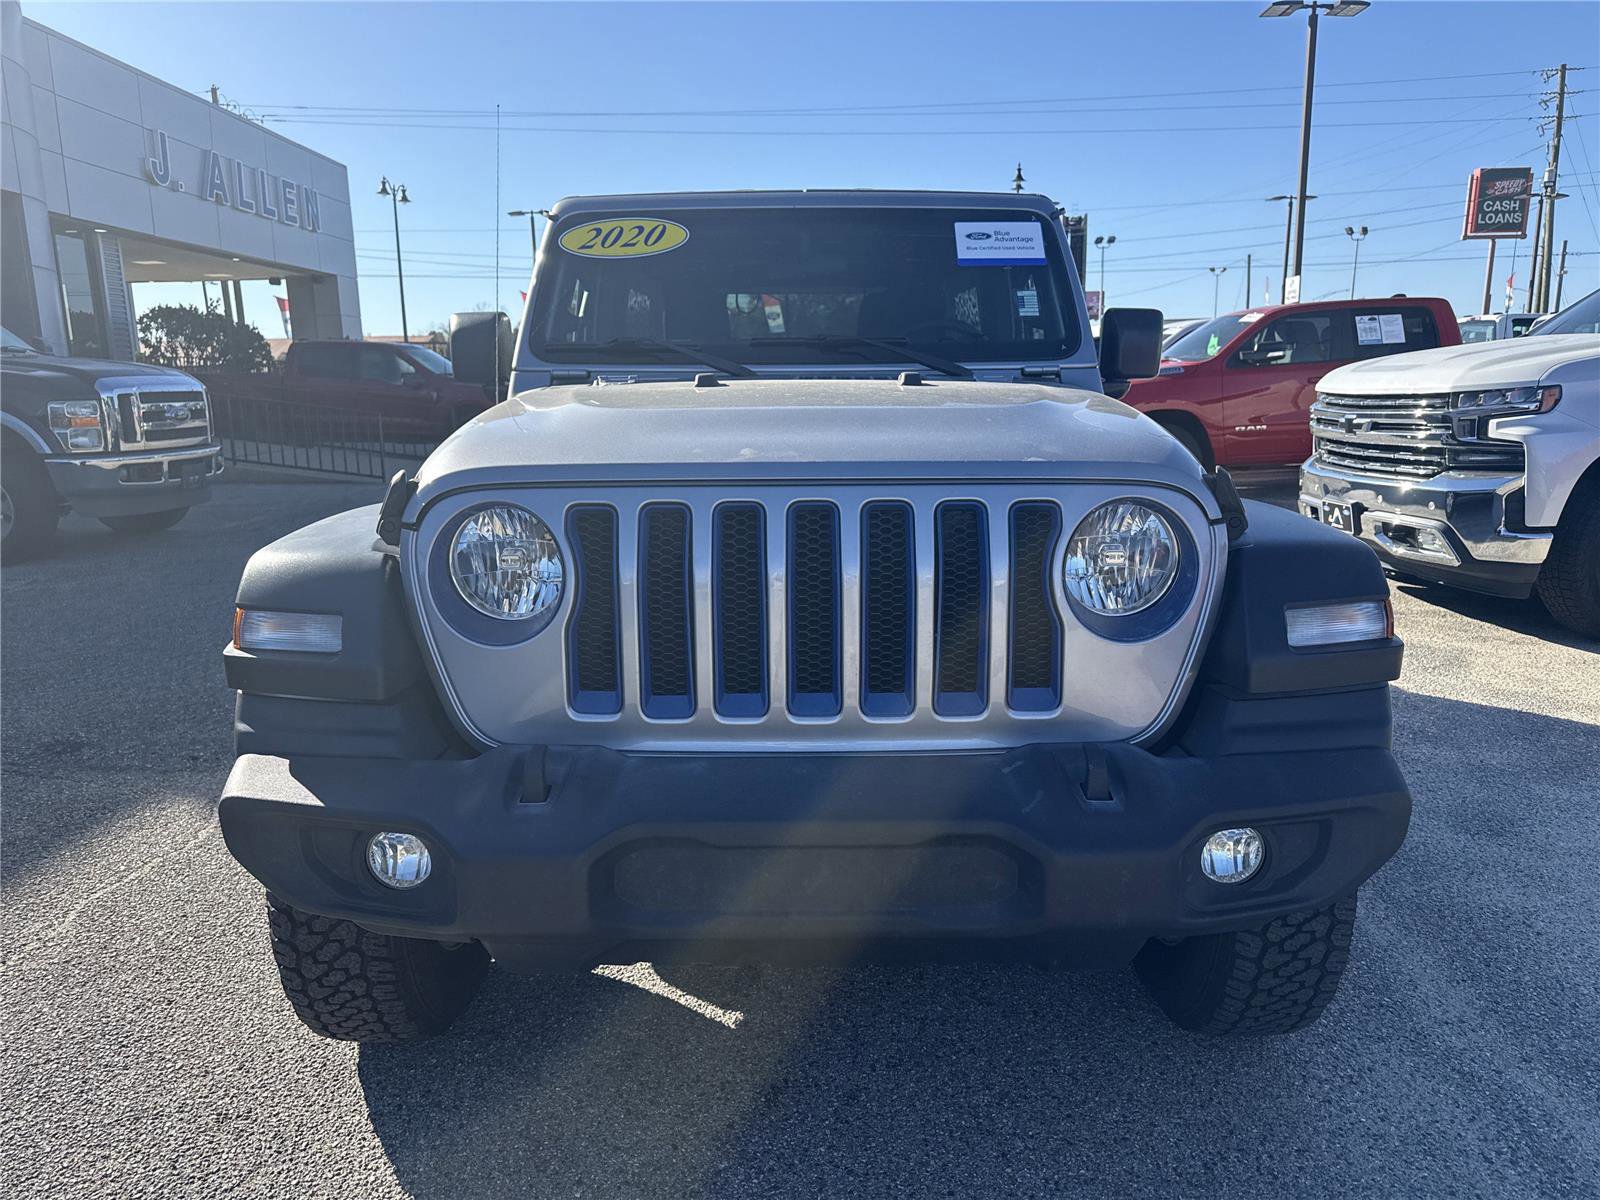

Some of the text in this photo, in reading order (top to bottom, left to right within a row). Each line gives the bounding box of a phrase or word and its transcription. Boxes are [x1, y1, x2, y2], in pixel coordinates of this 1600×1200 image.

[148, 129, 322, 233] J. ALLEN
[1483, 200, 1520, 211] CASH
[1478, 212, 1522, 224] LOANS
[577, 224, 667, 250] 2020
[1235, 424, 1267, 432] RAM
